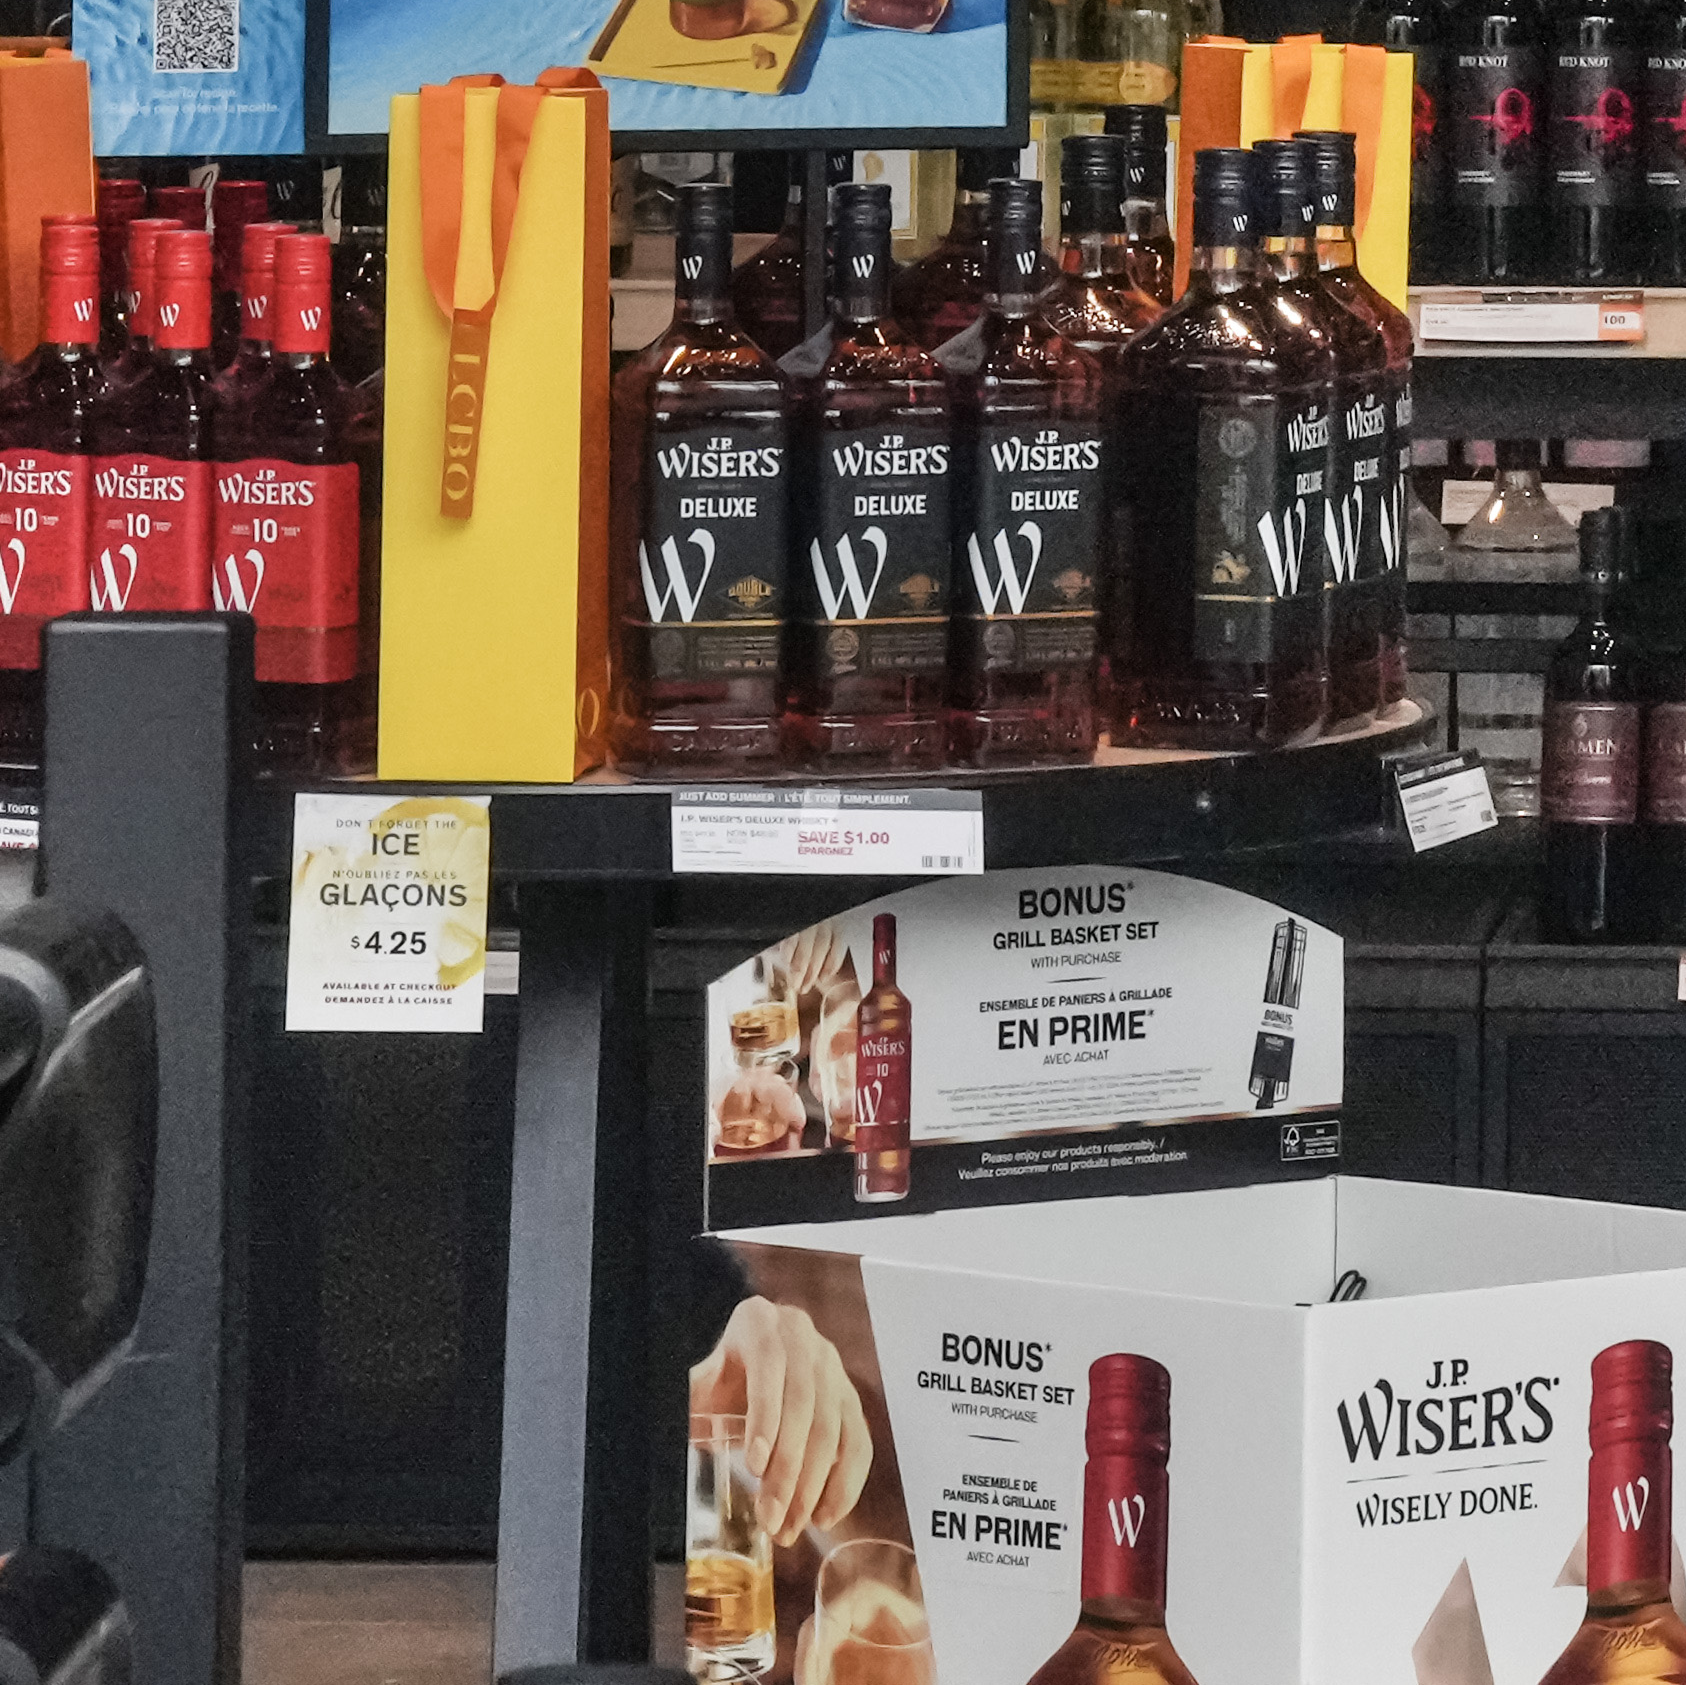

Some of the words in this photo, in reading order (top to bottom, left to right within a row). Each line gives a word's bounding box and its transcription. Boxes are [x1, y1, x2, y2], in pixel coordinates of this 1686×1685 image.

[1478, 55, 1508, 68] KNOT
[1579, 56, 1609, 68] KNOT
[444, 353, 481, 501] LCBO
[657, 442, 780, 479] WISER'S
[832, 441, 949, 477] WISER'S
[990, 436, 1100, 473] WISER'S
[95, 467, 186, 502] WISER'S
[218, 472, 315, 507] WISER'S
[680, 497, 757, 518] DELUXE
[854, 495, 926, 516] DELUXE
[1011, 490, 1079, 511] DELUXE
[126, 513, 151, 539] 10
[253, 518, 278, 543] 10
[639, 528, 715, 623] W
[809, 526, 887, 621] W
[967, 520, 1042, 616] W
[729, 793, 774, 802] SUMMER
[336, 820, 373, 828] DONT
[379, 820, 428, 828] FORGET
[372, 834, 420, 855] ICE
[798, 846, 854, 855] ÉPARGNEZ
[799, 831, 838, 844] SAVE
[844, 832, 890, 844] $1.00
[333, 870, 400, 879] N'OUBLIEZ
[406, 870, 428, 879] PAS
[435, 871, 456, 880] LES
[320, 884, 467, 912] GLAÇONS
[994, 930, 1045, 950] GRILL
[1051, 925, 1121, 945] BASKET
[1126, 922, 1159, 939] SET
[979, 997, 1037, 1013] ENSEMBLE
[1041, 996, 1055, 1008] DE
[1059, 992, 1106, 1006] PANIERS
[1119, 988, 1172, 1002] GRILLADE
[998, 1019, 1038, 1050] EN
[1426, 1359, 1468, 1389] J.P.
[917, 1371, 966, 1393] GRILL
[971, 1376, 1037, 1402] BASKET
[1043, 1386, 1074, 1406] SET
[951, 1402, 977, 1416] WITH
[980, 1406, 1038, 1423] PURCHASE
[1337, 1376, 1555, 1464] WISER'S
[962, 1474, 1020, 1492] ENSEMBLE
[1023, 1479, 1038, 1493] DE
[943, 1489, 989, 1505] PANIERS
[991, 1489, 1000, 1506] À
[1002, 1495, 1057, 1511] GRILLADE
[1356, 1492, 1452, 1528] WISELY
[1460, 1483, 1539, 1517] DONE.
[931, 1511, 968, 1542] EN
[966, 1552, 994, 1565] AVEC
[996, 1554, 1030, 1568] ACHAT
